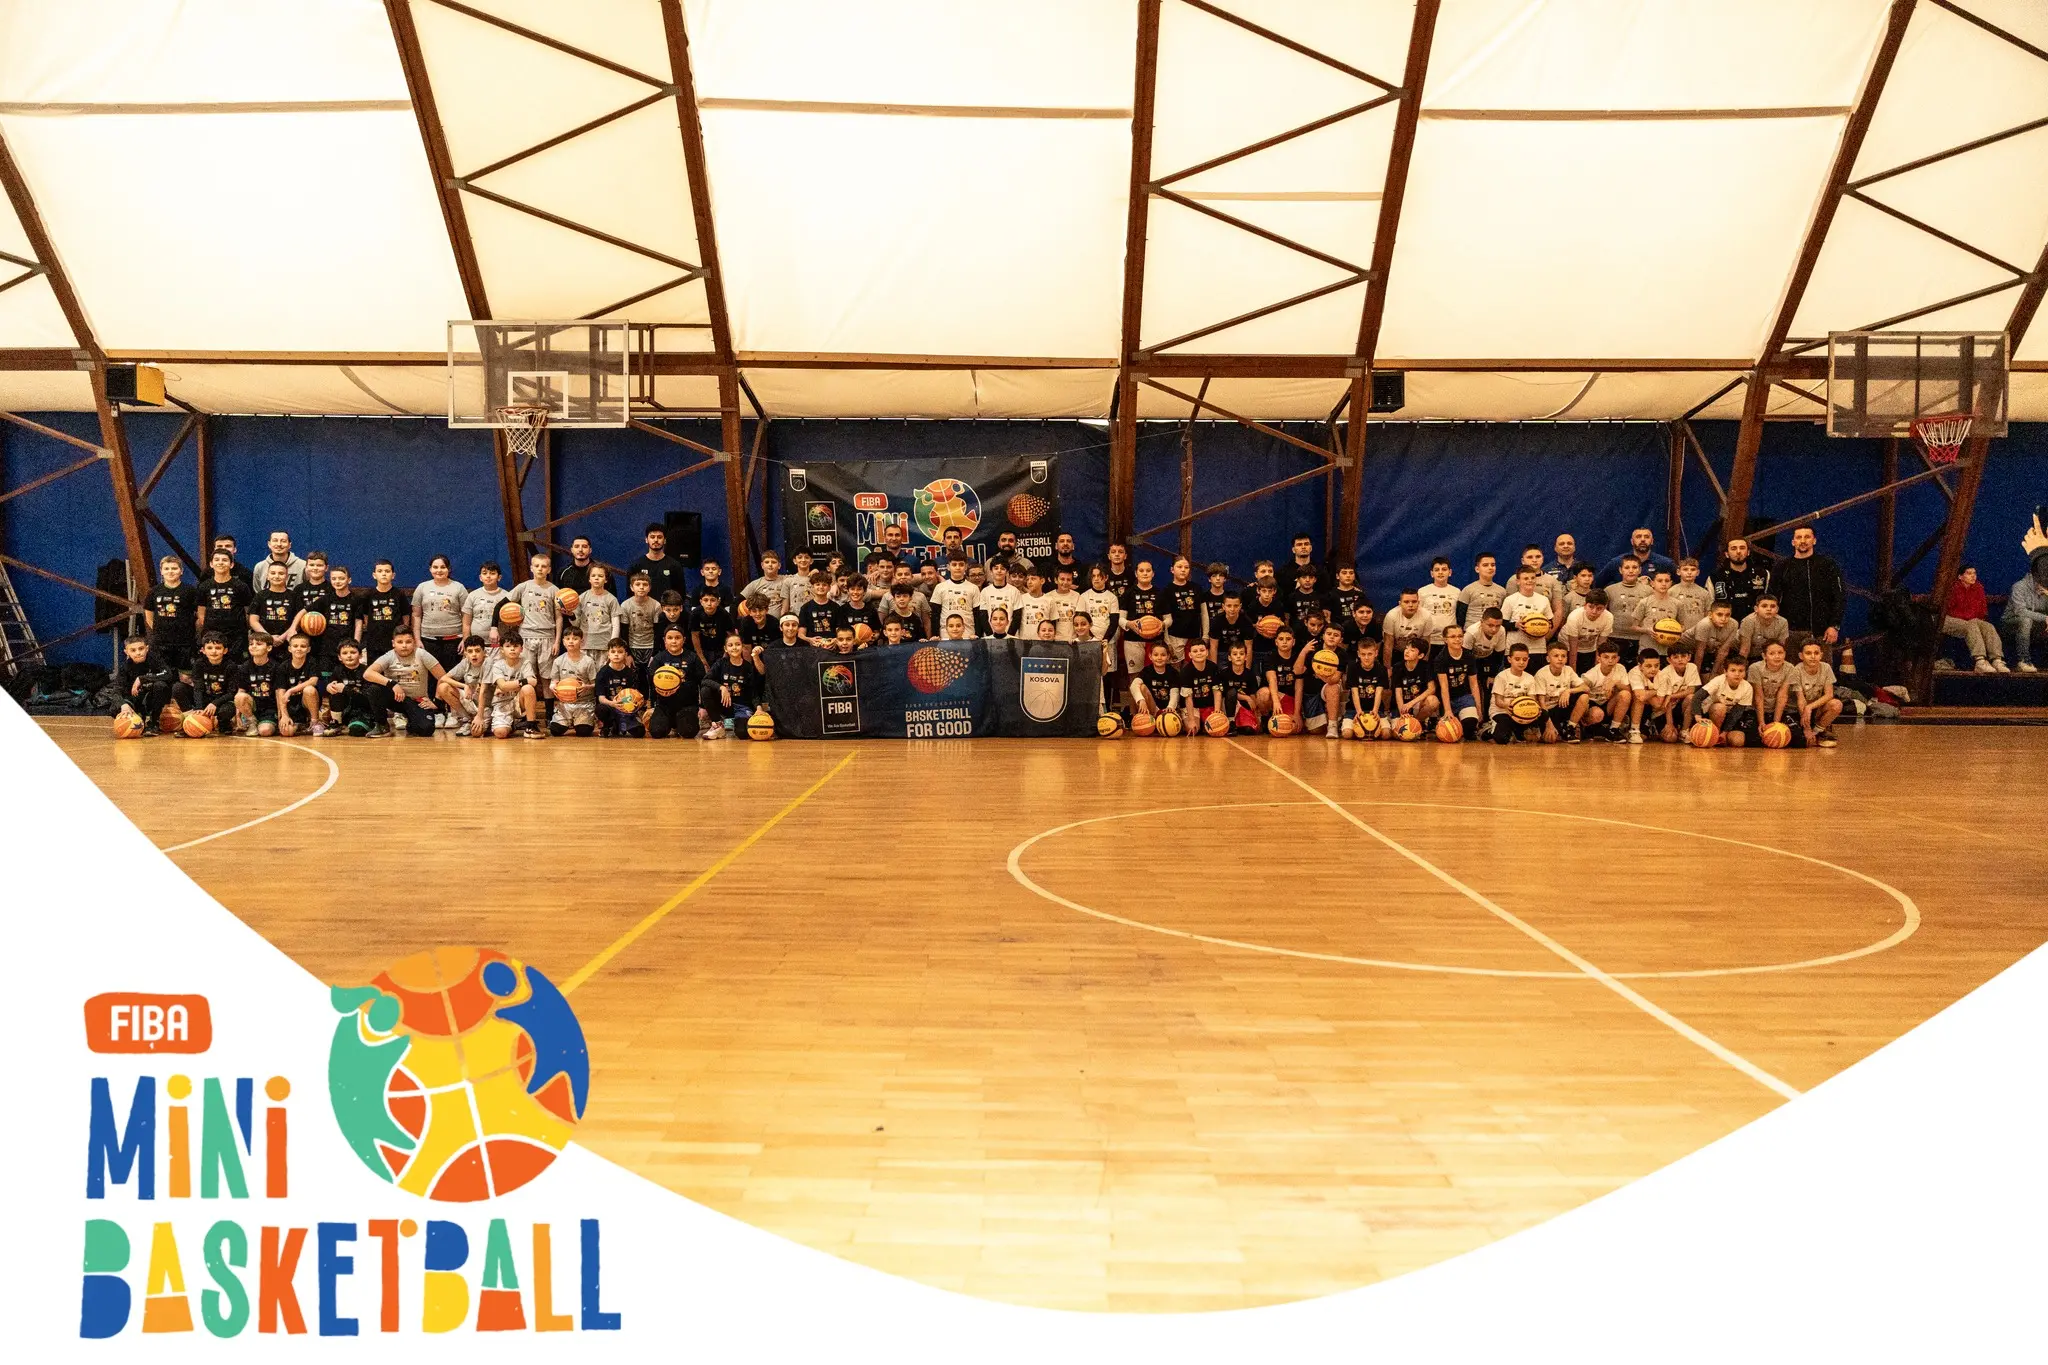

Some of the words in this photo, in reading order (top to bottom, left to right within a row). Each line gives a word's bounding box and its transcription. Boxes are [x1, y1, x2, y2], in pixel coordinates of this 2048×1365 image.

[861, 496, 881, 507] FIBA
[812, 534, 833, 545] FIBA
[1026, 546, 1052, 558] GOOD
[1029, 676, 1060, 684] KOSOVA
[827, 701, 853, 715] FIBA
[905, 707, 972, 723] BASKETBALL
[906, 722, 933, 739] FOR
[936, 720, 972, 737] GOOD
